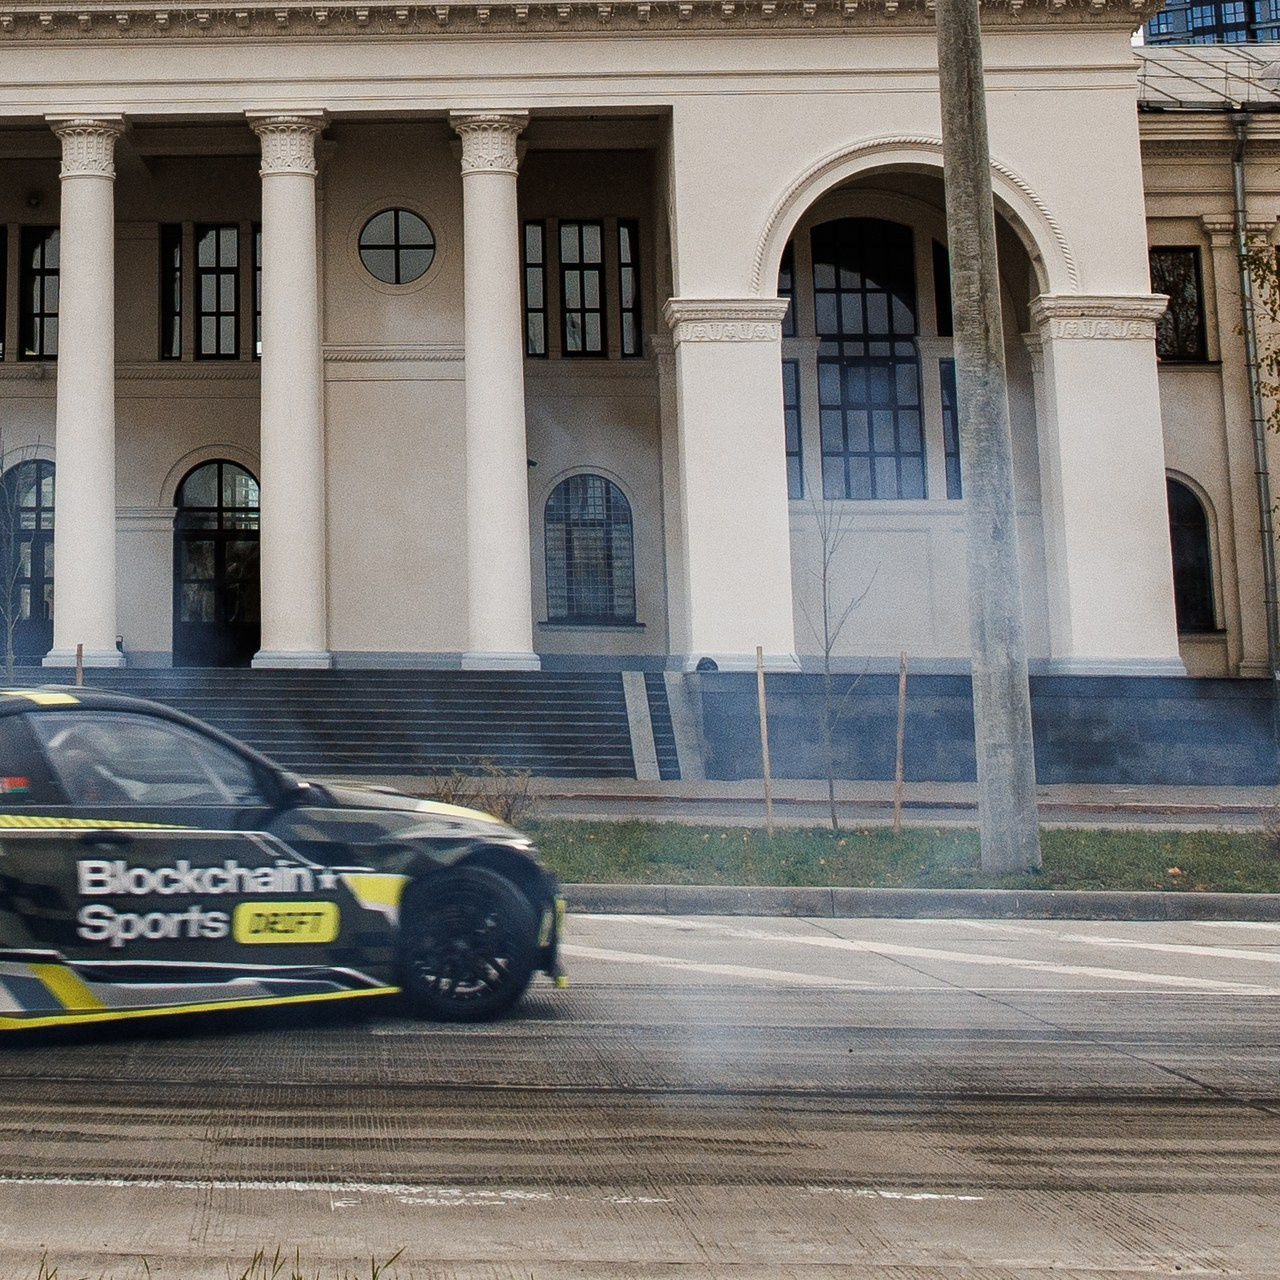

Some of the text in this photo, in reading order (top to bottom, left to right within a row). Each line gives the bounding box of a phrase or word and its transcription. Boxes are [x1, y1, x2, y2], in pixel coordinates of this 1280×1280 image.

[78, 860, 315, 894] Blockchain
[77, 904, 324, 947] Sports DRIFT
